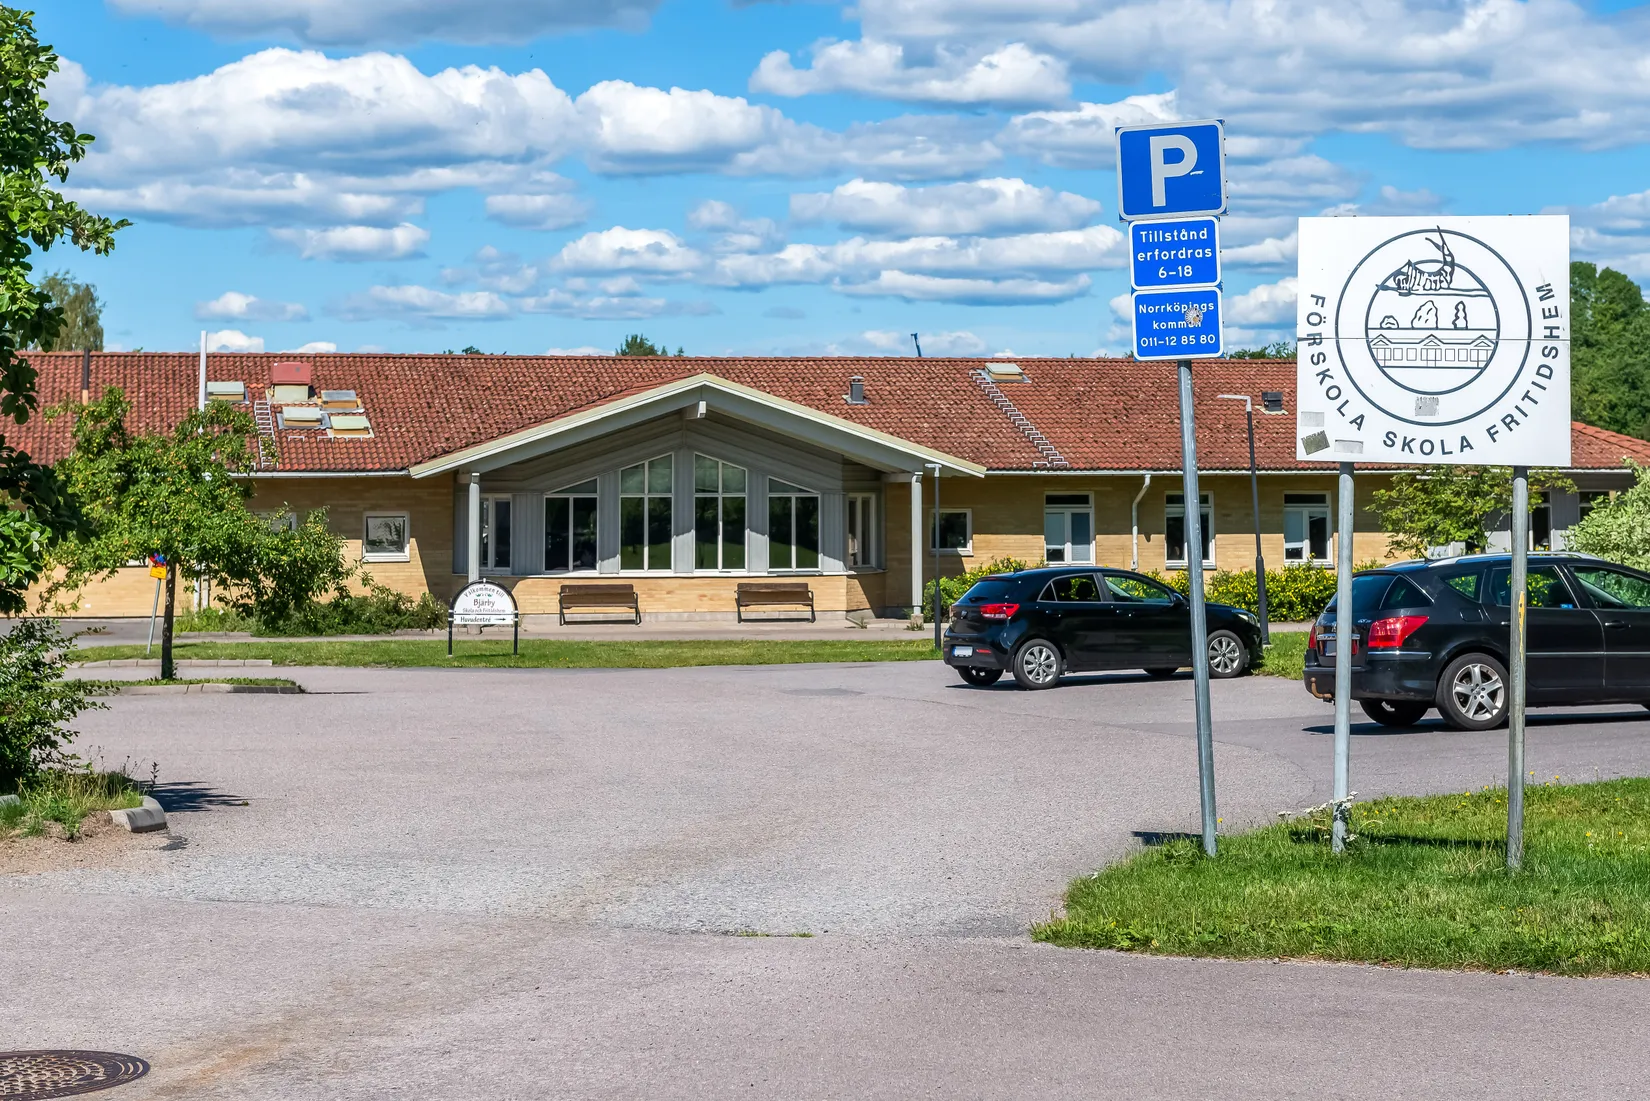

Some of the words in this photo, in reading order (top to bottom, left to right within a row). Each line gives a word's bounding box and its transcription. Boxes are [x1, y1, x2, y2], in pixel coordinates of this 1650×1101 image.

[1150, 134, 1198, 208] P
[1140, 227, 1208, 243] Tillstånd
[1137, 247, 1212, 262] erfordras
[1158, 265, 1193, 279] 6-18
[1139, 301, 1215, 314] Norrköpings
[1140, 336, 1177, 347] 011-12
[1181, 335, 1196, 345] 85
[1200, 334, 1216, 344] 80
[1306, 293, 1366, 431] FÖRSKOLA
[1382, 430, 1474, 456] SKOLA
[1485, 282, 1561, 443] FRITIDSHEM
